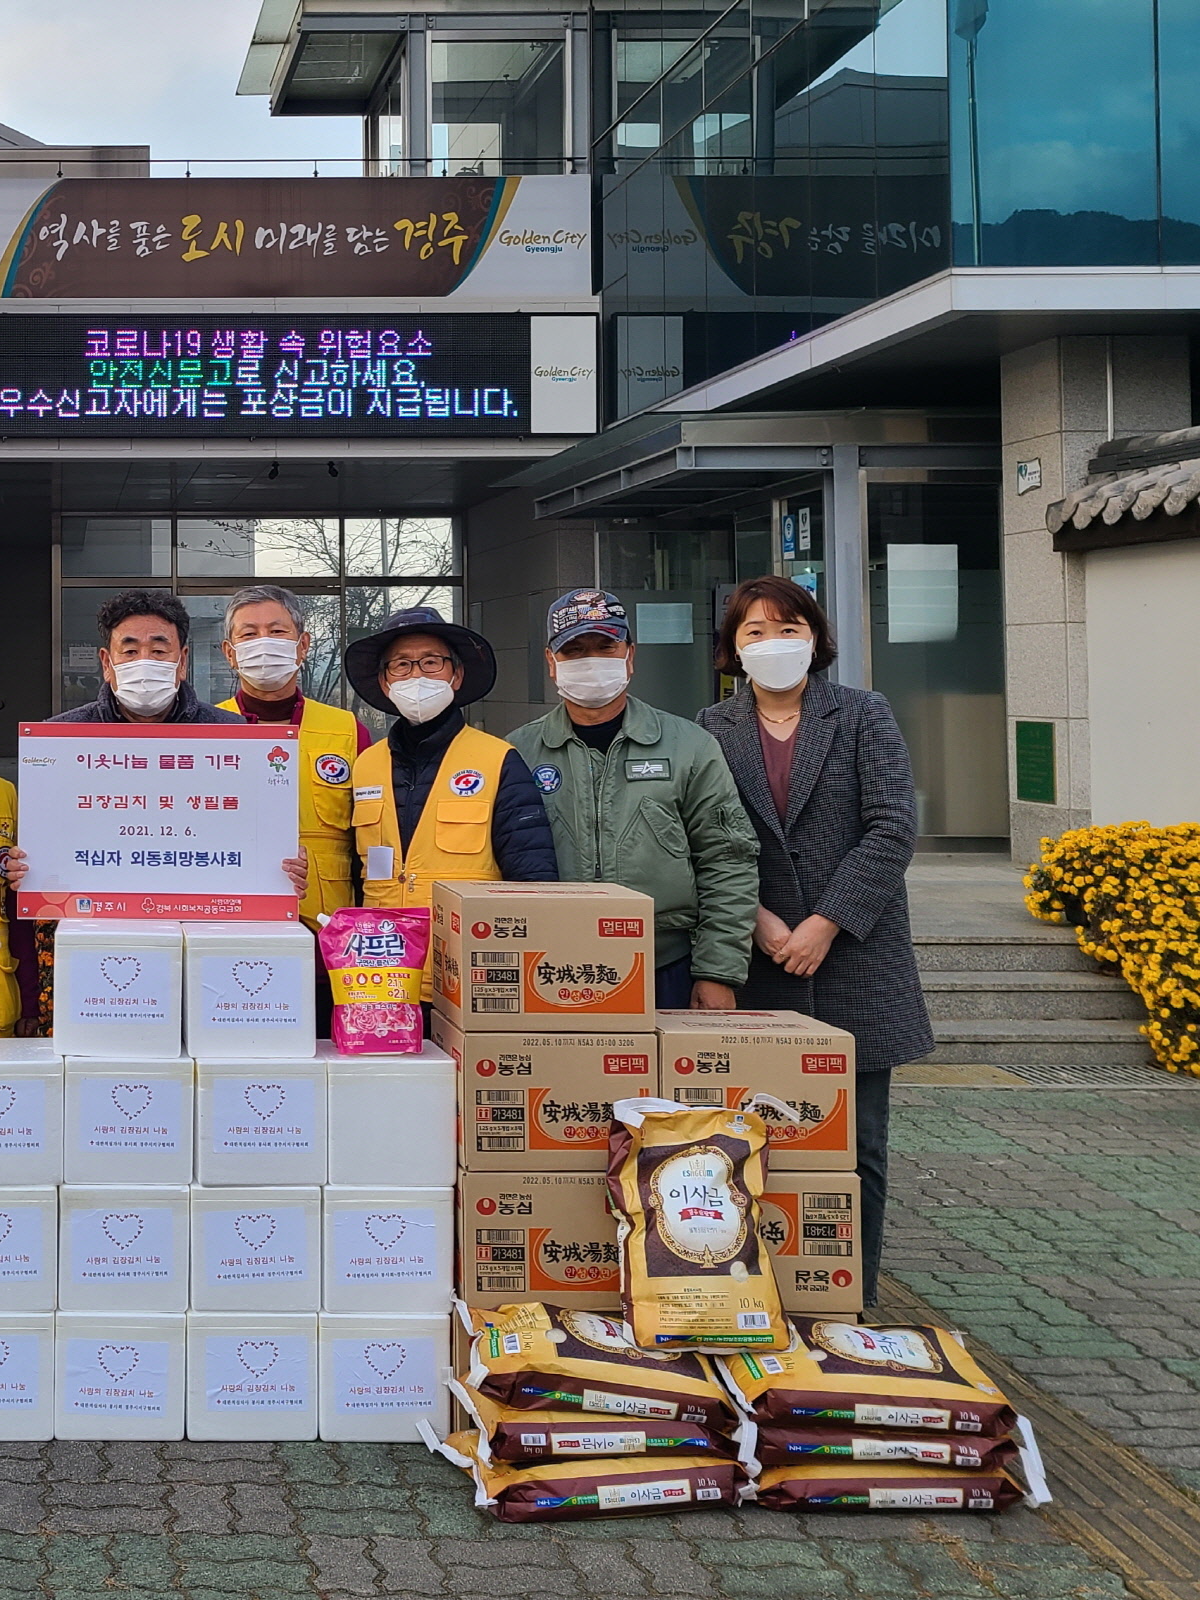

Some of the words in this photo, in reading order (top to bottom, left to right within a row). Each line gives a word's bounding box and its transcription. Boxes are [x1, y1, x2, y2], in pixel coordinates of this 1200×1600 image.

[39, 213, 121, 261] 역사를
[129, 221, 172, 257] 품은
[181, 214, 244, 262] 도시
[254, 221, 338, 257] 미래를
[346, 224, 390, 255] 담는
[393, 212, 469, 265] 경주
[499, 229, 551, 246] Golden
[553, 229, 588, 250] City
[85, 330, 201, 358] 코로나19
[211, 330, 269, 358] 생활
[279, 330, 305, 358] 속
[318, 330, 432, 358] 위험요소
[90, 359, 262, 387] 안전신문고로
[274, 359, 426, 387] 신고하세요.
[534, 366, 568, 378] Golden
[569, 367, 593, 380] City
[240, 389, 352, 417] 포상금이
[366, 389, 518, 417] 지급됩니다.
[76, 754, 148, 769] 이웃나눔
[158, 754, 194, 769] 물품
[205, 754, 241, 770] 기탁
[77, 795, 147, 809] 김장김치
[159, 796, 174, 809] 및
[187, 795, 239, 810] 생필품
[119, 826, 153, 836] 2021.
[160, 826, 177, 836] 12.
[185, 827, 197, 837] 6.
[75, 850, 122, 866] 적십자
[131, 850, 242, 867] 외동희망봉사회
[93, 901, 125, 912] 경주시
[156, 904, 171, 913] 경북
[493, 925, 527, 938] 농심
[602, 921, 640, 934] 멀티팩
[343, 933, 405, 957] 샤프란
[488, 971, 517, 981] 가3481
[537, 962, 621, 985] 安城湯麵
[110, 997, 139, 1005] 김장김치
[241, 1002, 271, 1010] 김장김치
[498, 1062, 531, 1075] 농심
[607, 1057, 644, 1071] 멀티팩
[696, 1059, 730, 1073] 농심
[806, 1057, 843, 1071] 멀티팩
[493, 1109, 522, 1119] 가3481
[254, 1126, 283, 1134] 김장김치
[669, 1185, 724, 1207] 이사금
[498, 1202, 532, 1214] 농심
[493, 1248, 523, 1260] 가3481
[739, 1298, 750, 1309] 10
[753, 1297, 765, 1310] kg
[615, 1400, 648, 1414] 이사금
[887, 1413, 920, 1424] 이사금
[630, 1488, 662, 1501] 이사금
[902, 1494, 933, 1505] 이사금
